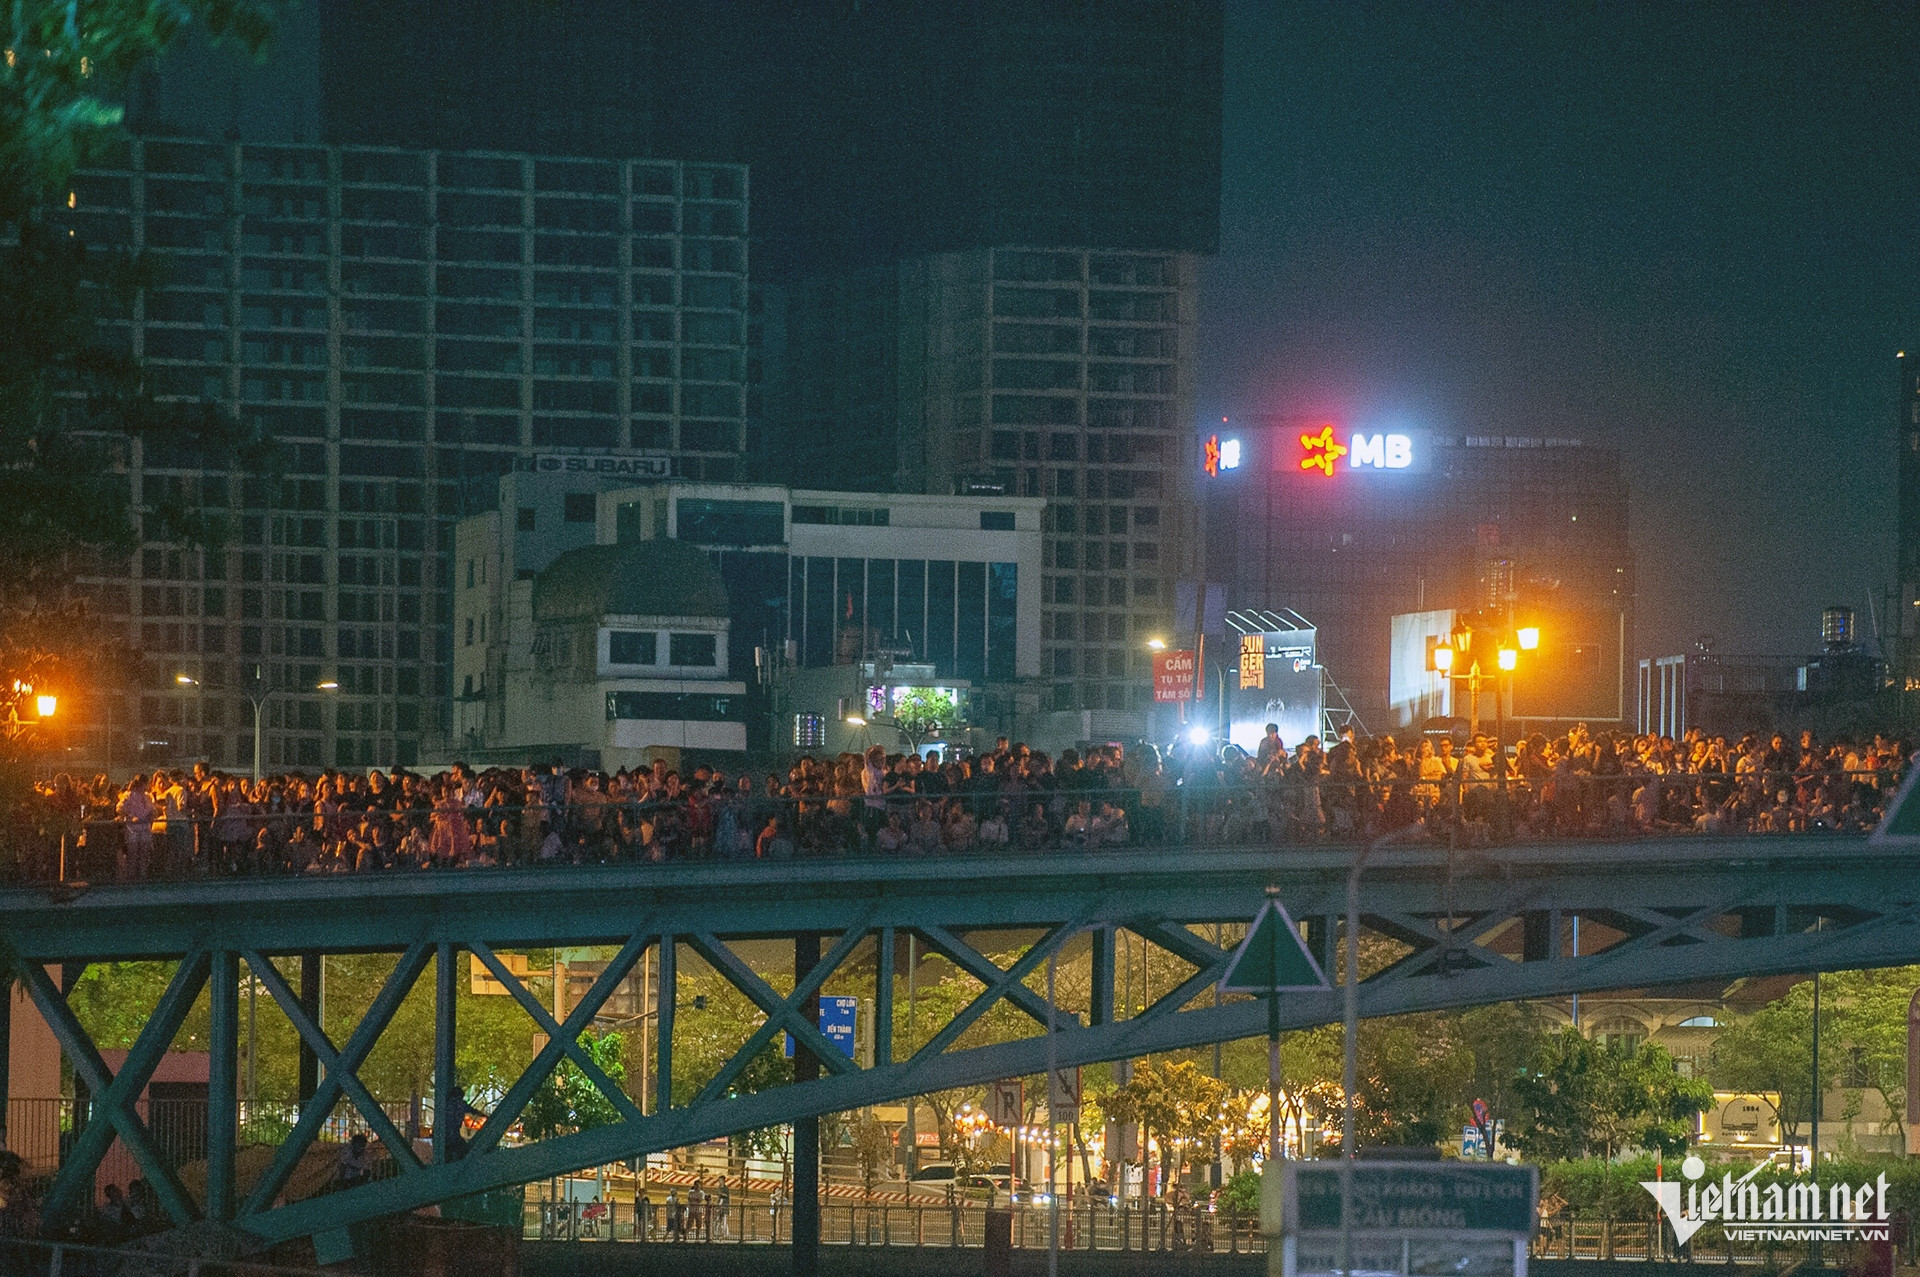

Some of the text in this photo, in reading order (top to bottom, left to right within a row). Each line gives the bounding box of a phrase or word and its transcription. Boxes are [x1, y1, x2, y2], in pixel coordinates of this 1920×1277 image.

[1351, 434, 1412, 468] MB
[565, 457, 666, 475] SUBARU
[1165, 649, 1193, 671] CẤM
[1161, 675, 1173, 686] TỤ
